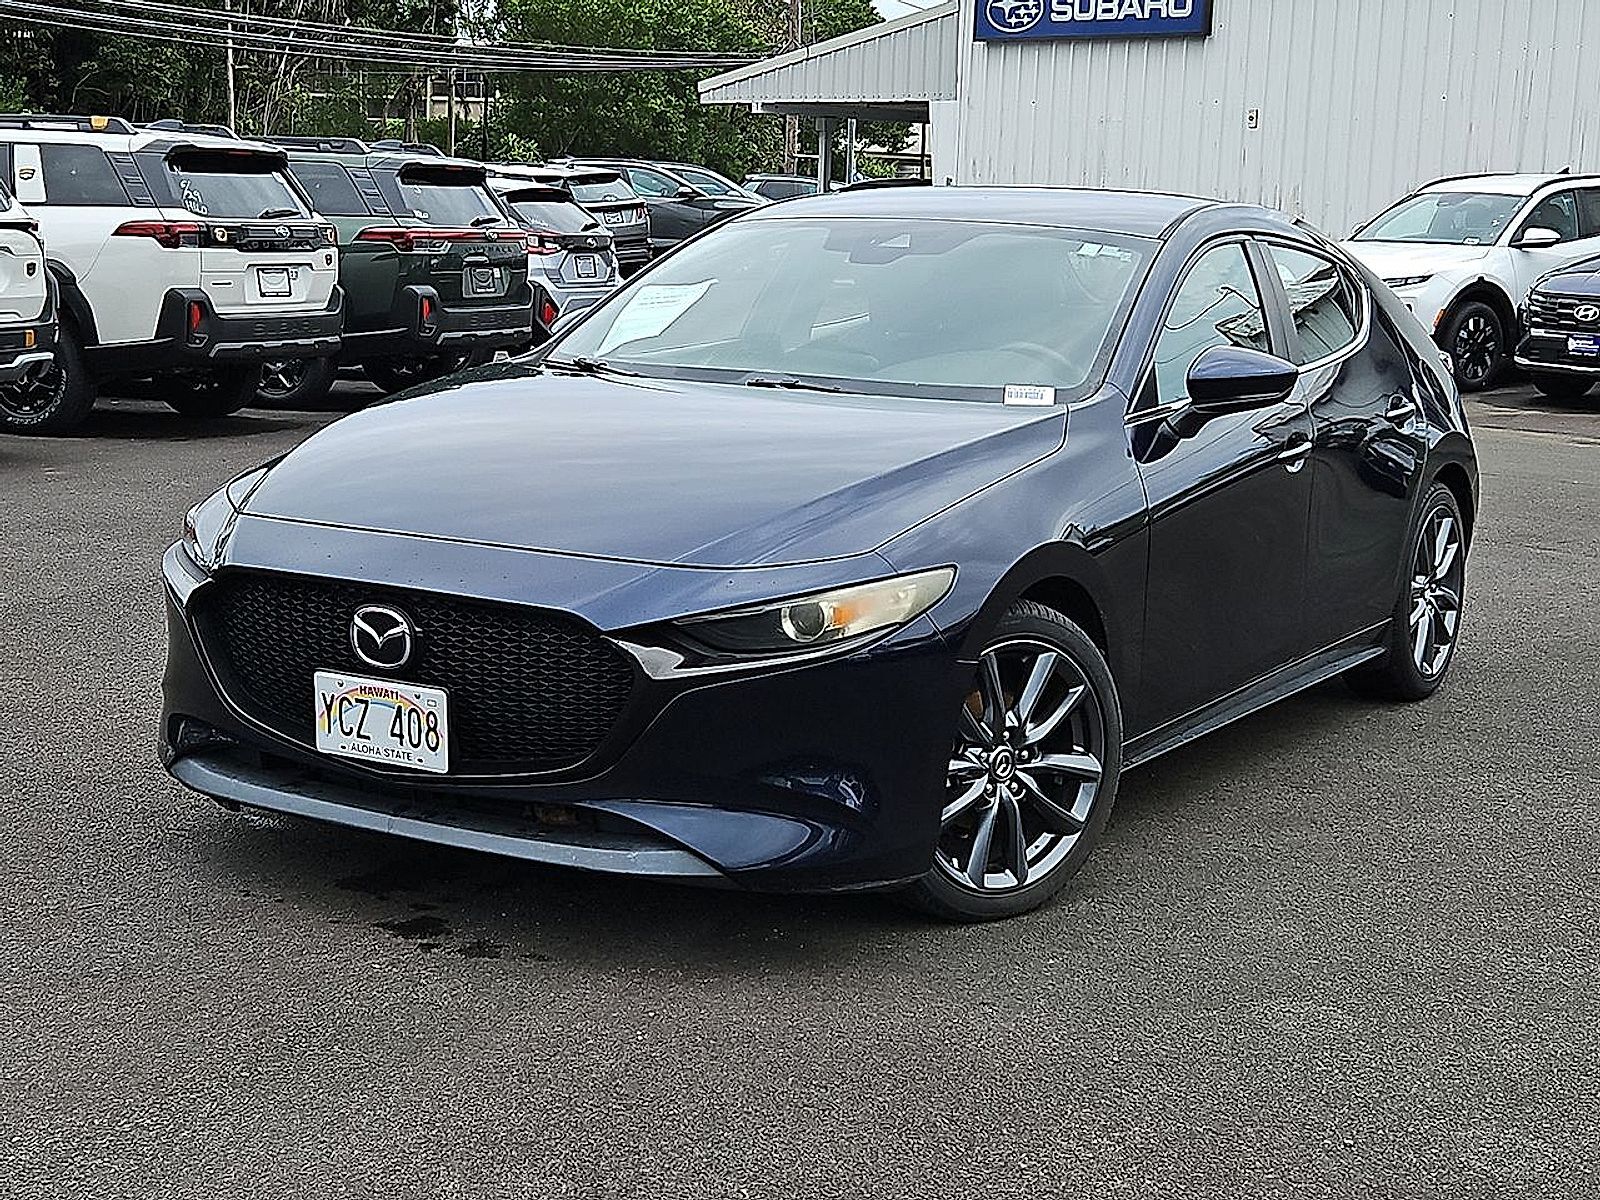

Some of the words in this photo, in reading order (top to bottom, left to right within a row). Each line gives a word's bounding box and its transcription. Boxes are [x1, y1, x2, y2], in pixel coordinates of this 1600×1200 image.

[1050, 0, 1193, 21] SUBARU
[359, 685, 399, 700] HAWAII
[321, 692, 371, 741] YCZ
[390, 703, 440, 752] 408
[351, 742, 382, 756] ALOHA
[383, 747, 413, 761] STATE
